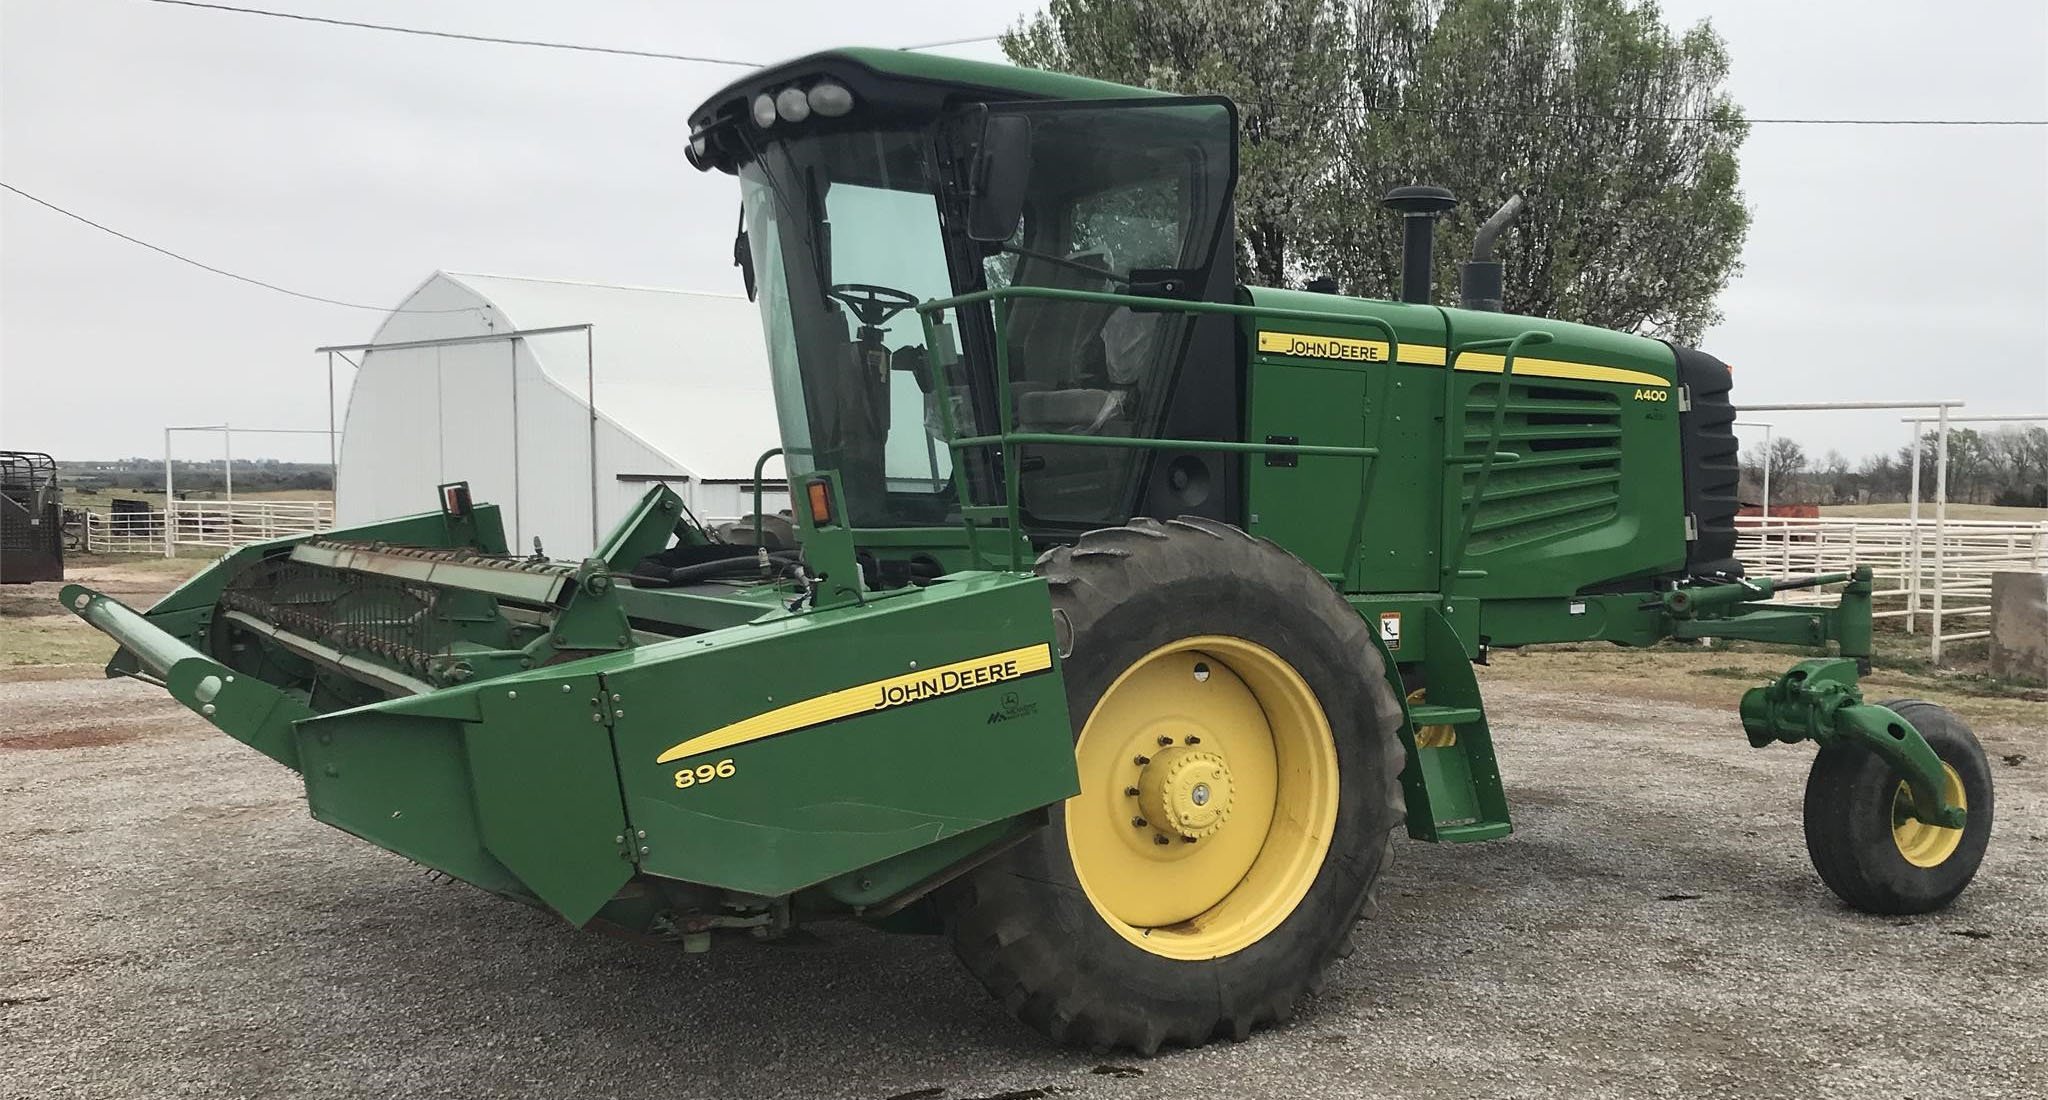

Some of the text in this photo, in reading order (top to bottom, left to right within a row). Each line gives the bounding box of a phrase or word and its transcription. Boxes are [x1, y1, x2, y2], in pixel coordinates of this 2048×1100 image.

[1286, 338, 1378, 360] JOHN DEERE
[1634, 388, 1668, 402] A400
[874, 660, 1018, 708] JOHN DEERE
[674, 758, 737, 789] 896
